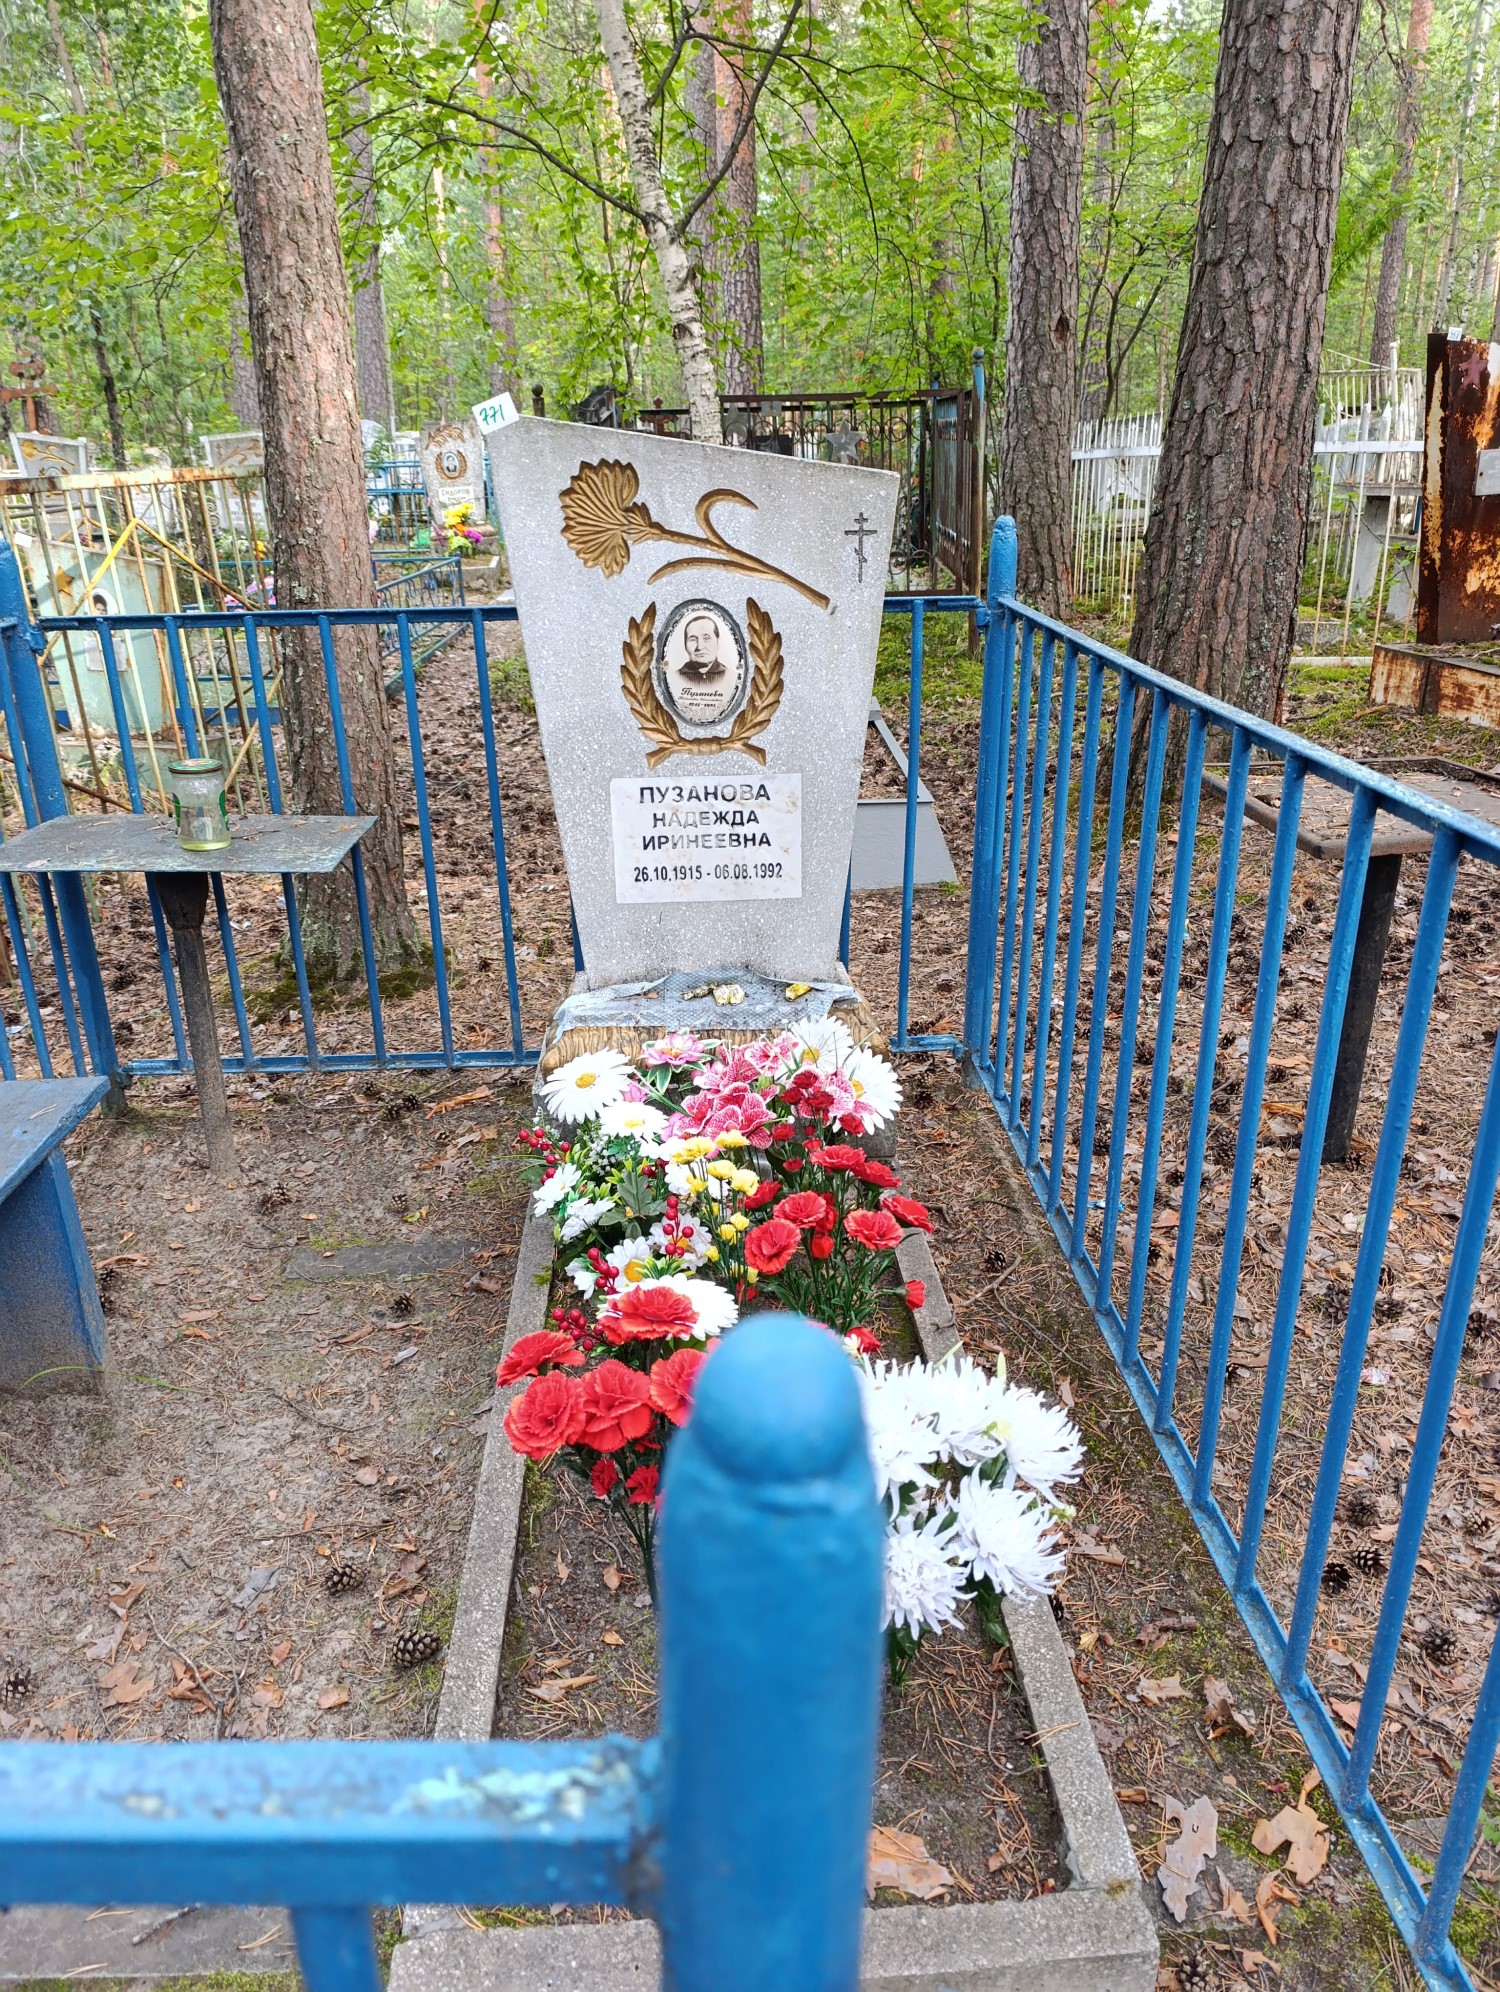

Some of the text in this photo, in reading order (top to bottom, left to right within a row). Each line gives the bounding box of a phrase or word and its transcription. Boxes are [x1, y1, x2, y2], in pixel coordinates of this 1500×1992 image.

[479, 404, 505, 425] 771
[639, 784, 771, 803] ПУЗАНОВА
[652, 810, 760, 828] НАДЕЖДА
[642, 832, 772, 850] ИРИНЕЕВНА
[633, 864, 703, 882] 26.10.1915
[714, 862, 783, 880] 06.08.1992
